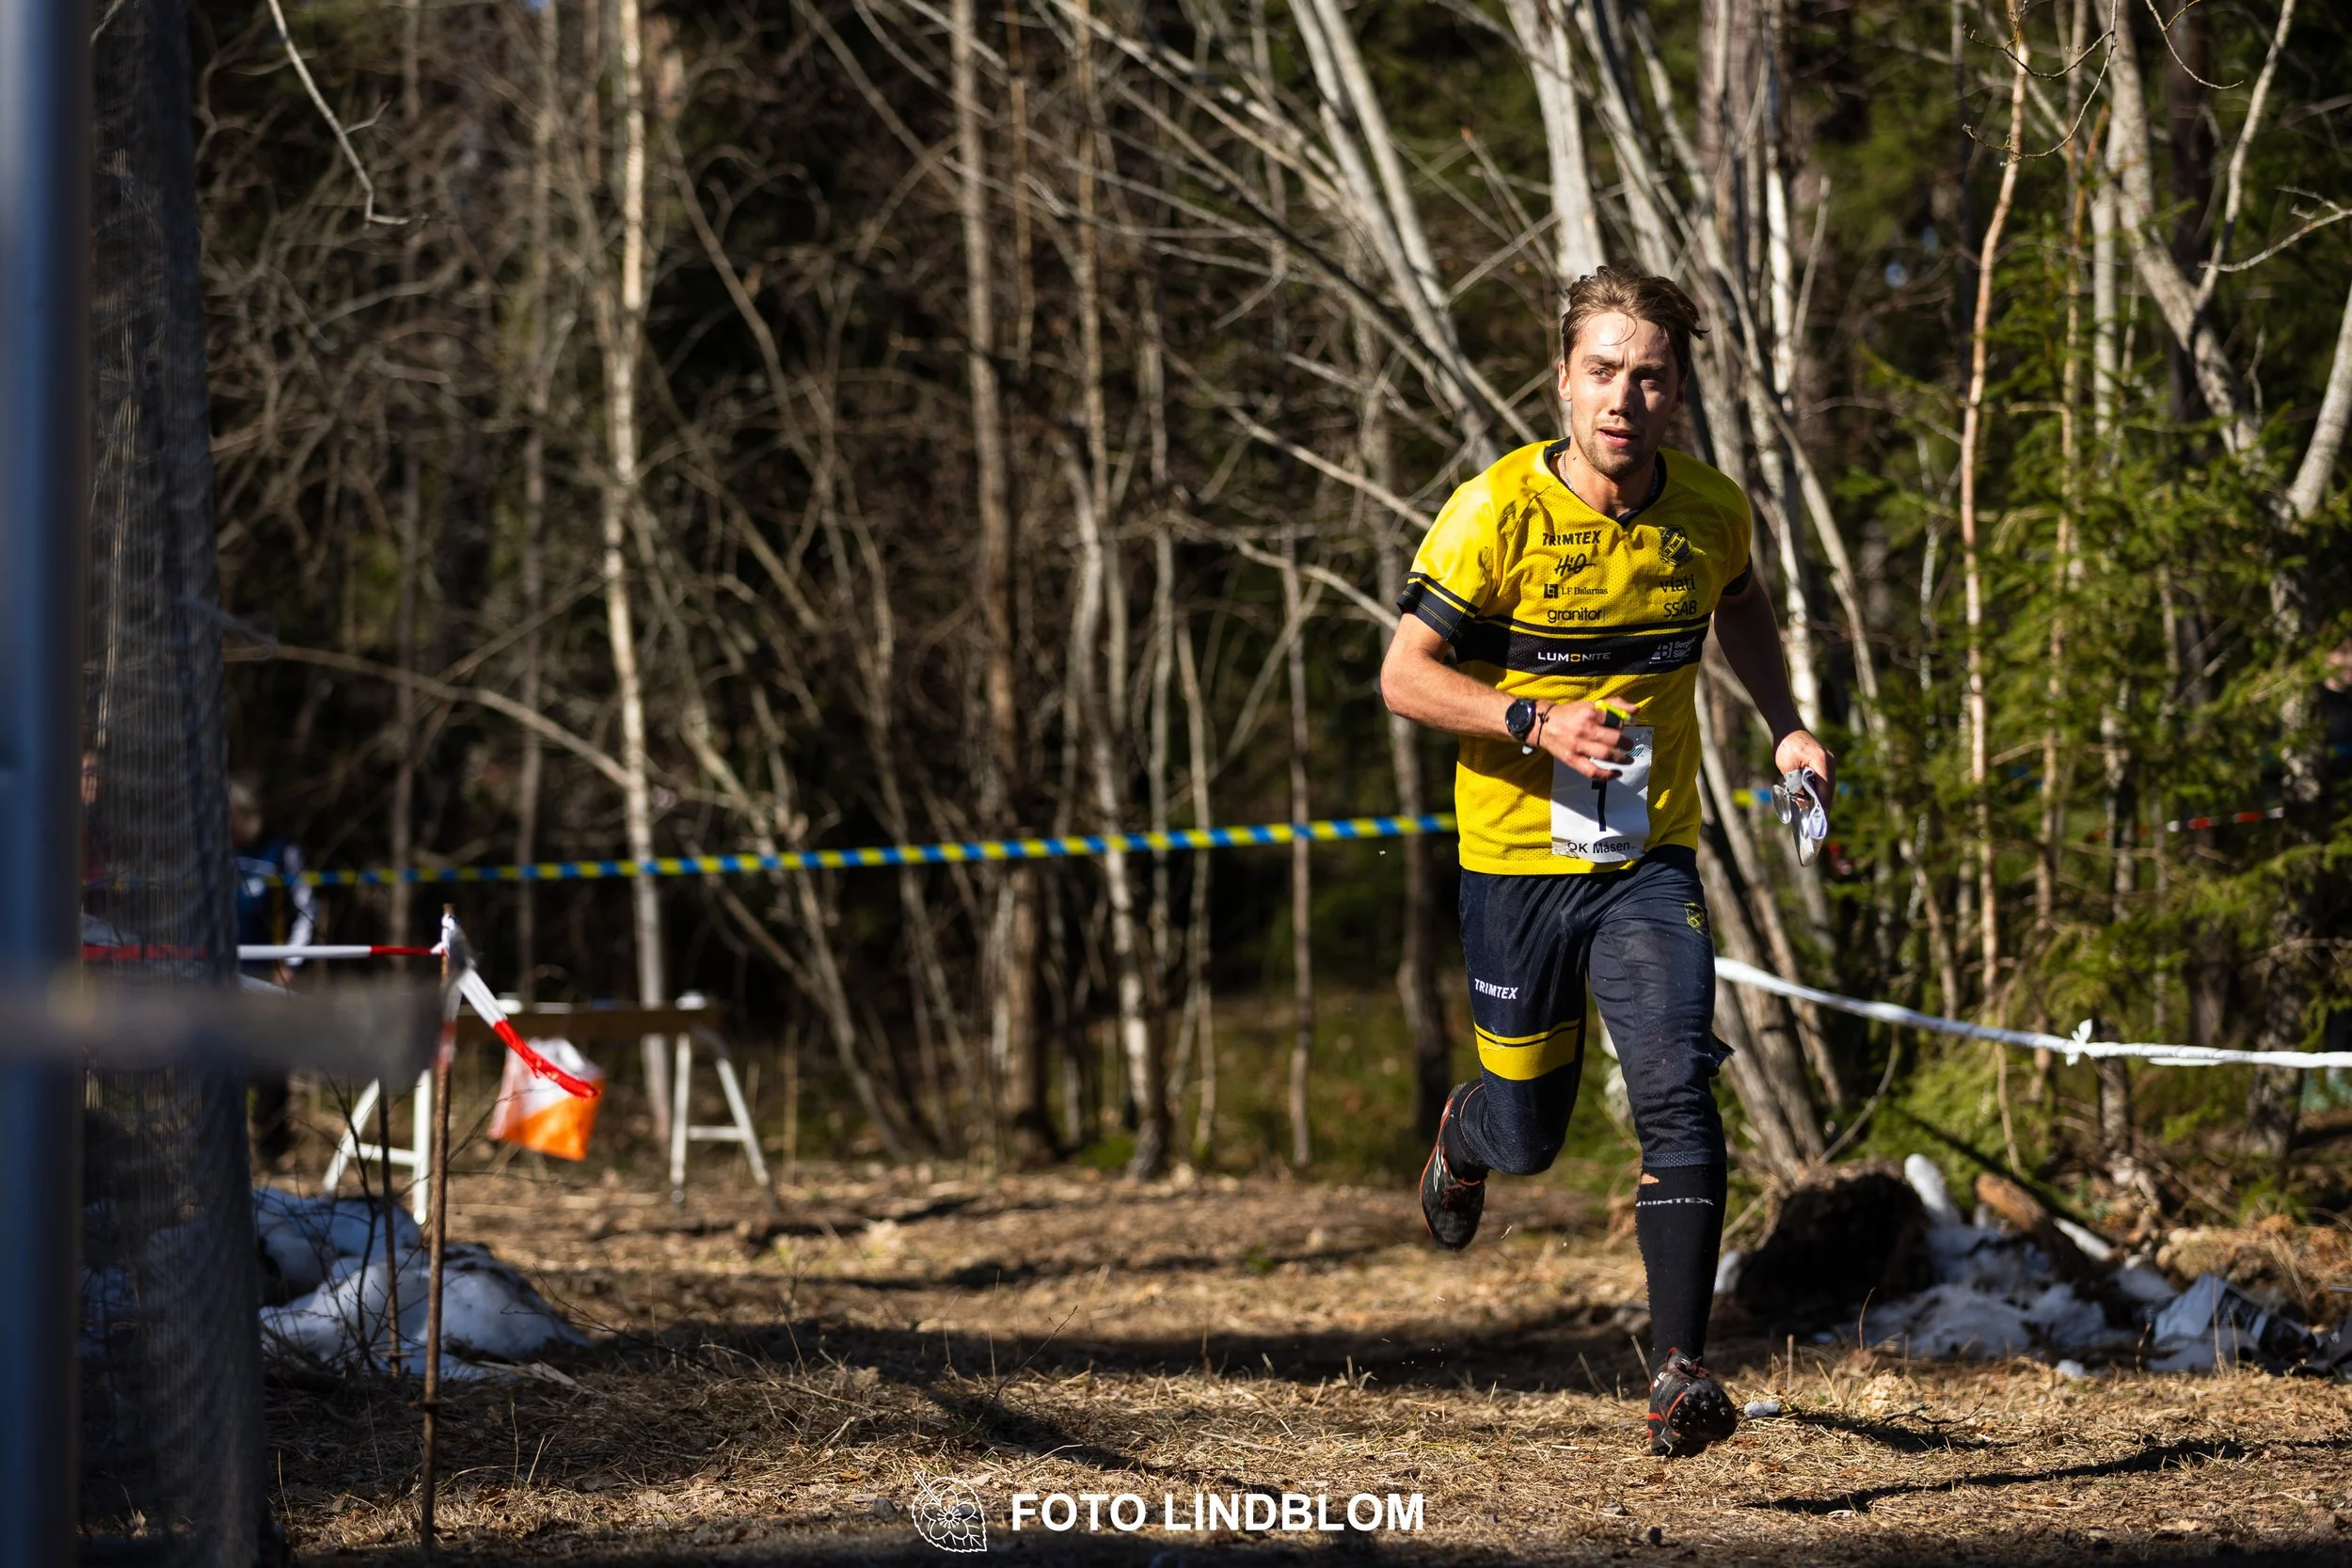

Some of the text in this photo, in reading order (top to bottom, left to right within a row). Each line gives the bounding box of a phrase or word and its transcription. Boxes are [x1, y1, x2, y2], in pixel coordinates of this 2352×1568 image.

[1543, 531, 1601, 546] TRIMTEX
[1574, 586, 1608, 595] Dalarnas
[1548, 607, 1602, 624] granitor
[1663, 600, 1697, 618] SSAB
[1537, 652, 1612, 662] LUMONITE
[1567, 842, 1588, 854] OK
[1474, 978, 1518, 1000] TRIMTEX
